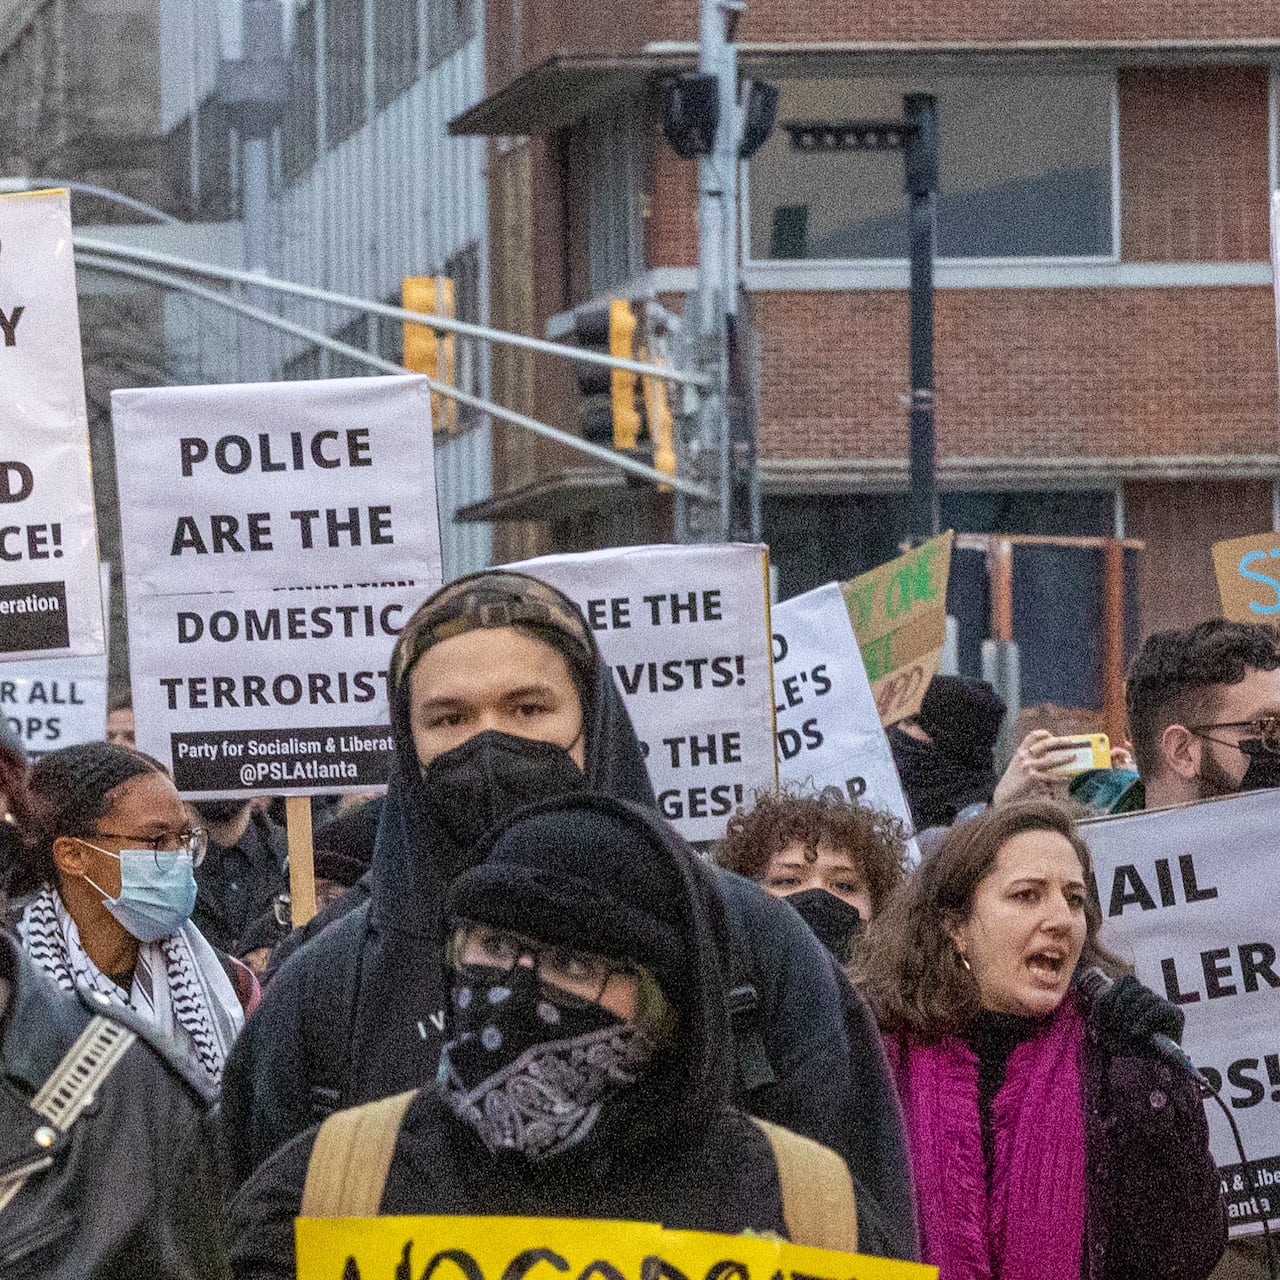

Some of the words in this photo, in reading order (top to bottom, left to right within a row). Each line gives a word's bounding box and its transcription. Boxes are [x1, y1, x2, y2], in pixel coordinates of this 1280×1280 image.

[180, 428, 371, 476] POLICE
[171, 511, 273, 556] ARE
[290, 506, 394, 549] THE
[177, 604, 405, 643] DOMESTIC
[643, 590, 722, 626] THE
[28, 681, 84, 705] ALL
[178, 738, 216, 759] Party
[221, 737, 243, 756] for
[248, 734, 319, 756] Socialism
[325, 734, 336, 752] &
[663, 732, 742, 769] THE
[240, 759, 358, 785] @PSLAtlanta
